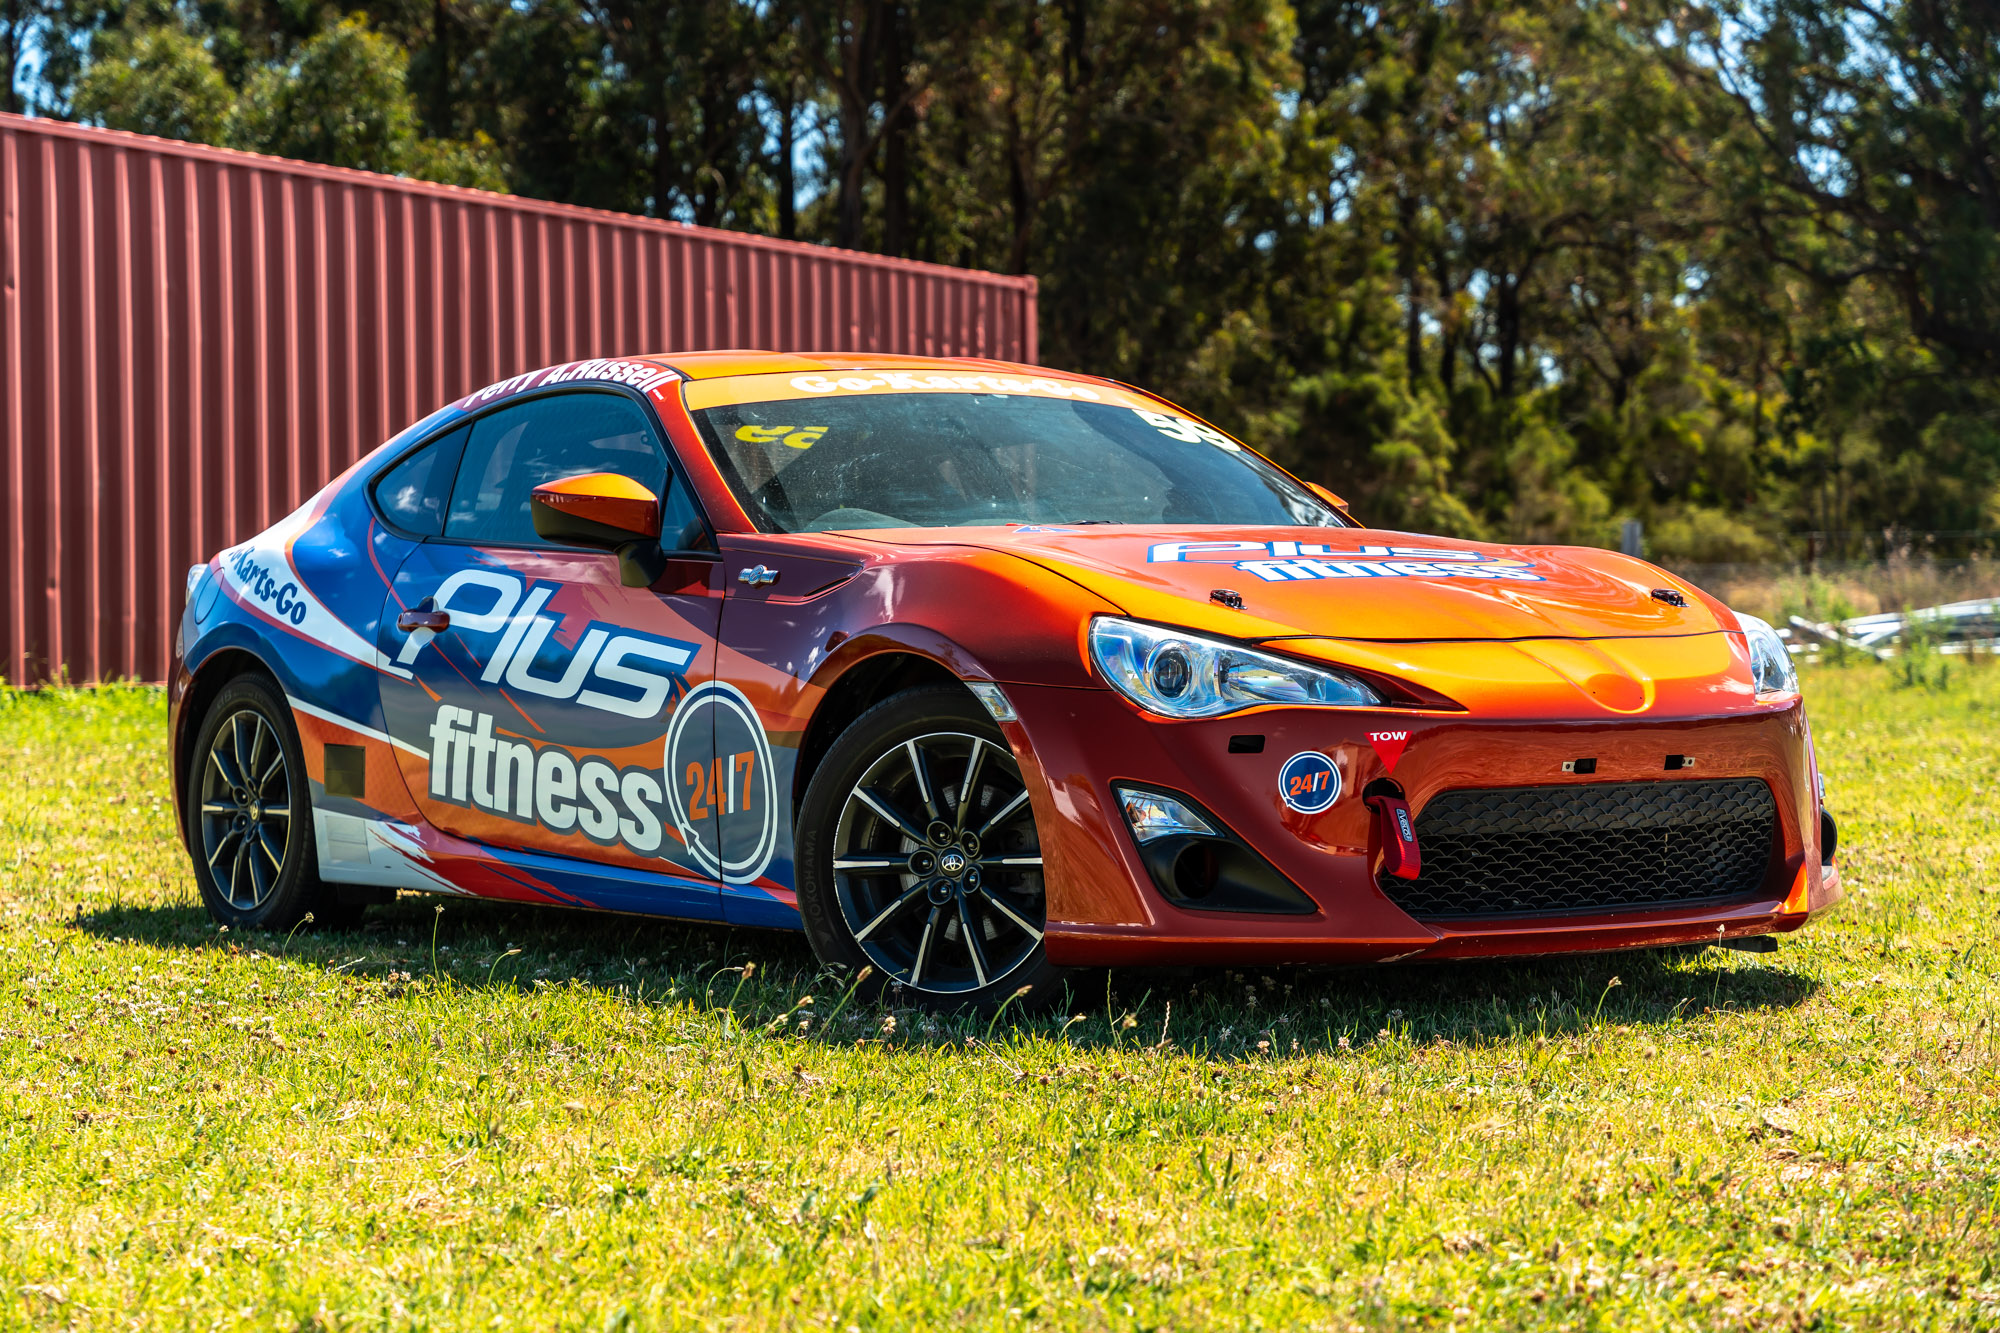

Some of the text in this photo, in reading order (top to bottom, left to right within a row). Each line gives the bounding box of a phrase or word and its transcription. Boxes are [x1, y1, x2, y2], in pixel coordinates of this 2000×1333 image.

[1148, 541, 1483, 562] Plus
[1236, 559, 1544, 582] fitness
[1369, 731, 1408, 742] TOW
[429, 704, 662, 851] fitness
[686, 751, 756, 821] 24/7
[1289, 770, 1331, 797] 24/7
[804, 829, 827, 932] YOKOHAMA
